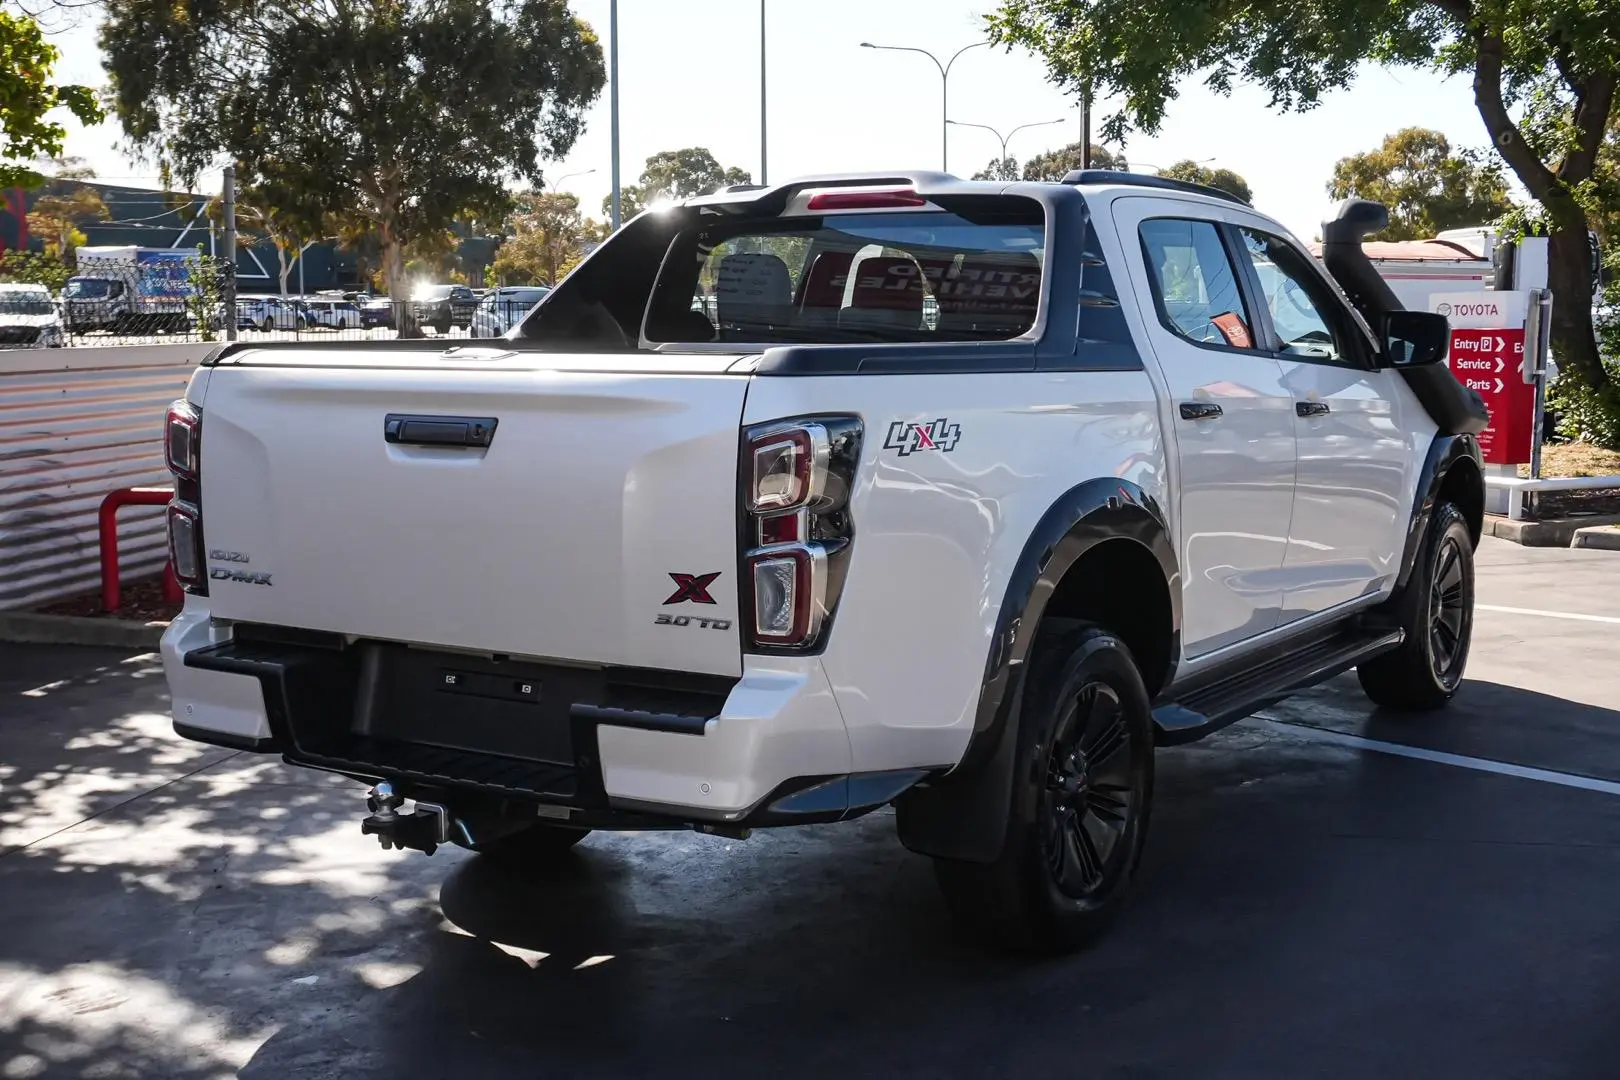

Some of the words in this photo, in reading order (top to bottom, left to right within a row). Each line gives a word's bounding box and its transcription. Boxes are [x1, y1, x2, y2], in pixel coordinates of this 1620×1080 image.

[1454, 304, 1498, 316] TOYOTA
[1454, 338, 1479, 352] Entry
[1456, 358, 1492, 370] Service
[1466, 378, 1491, 390] Parts
